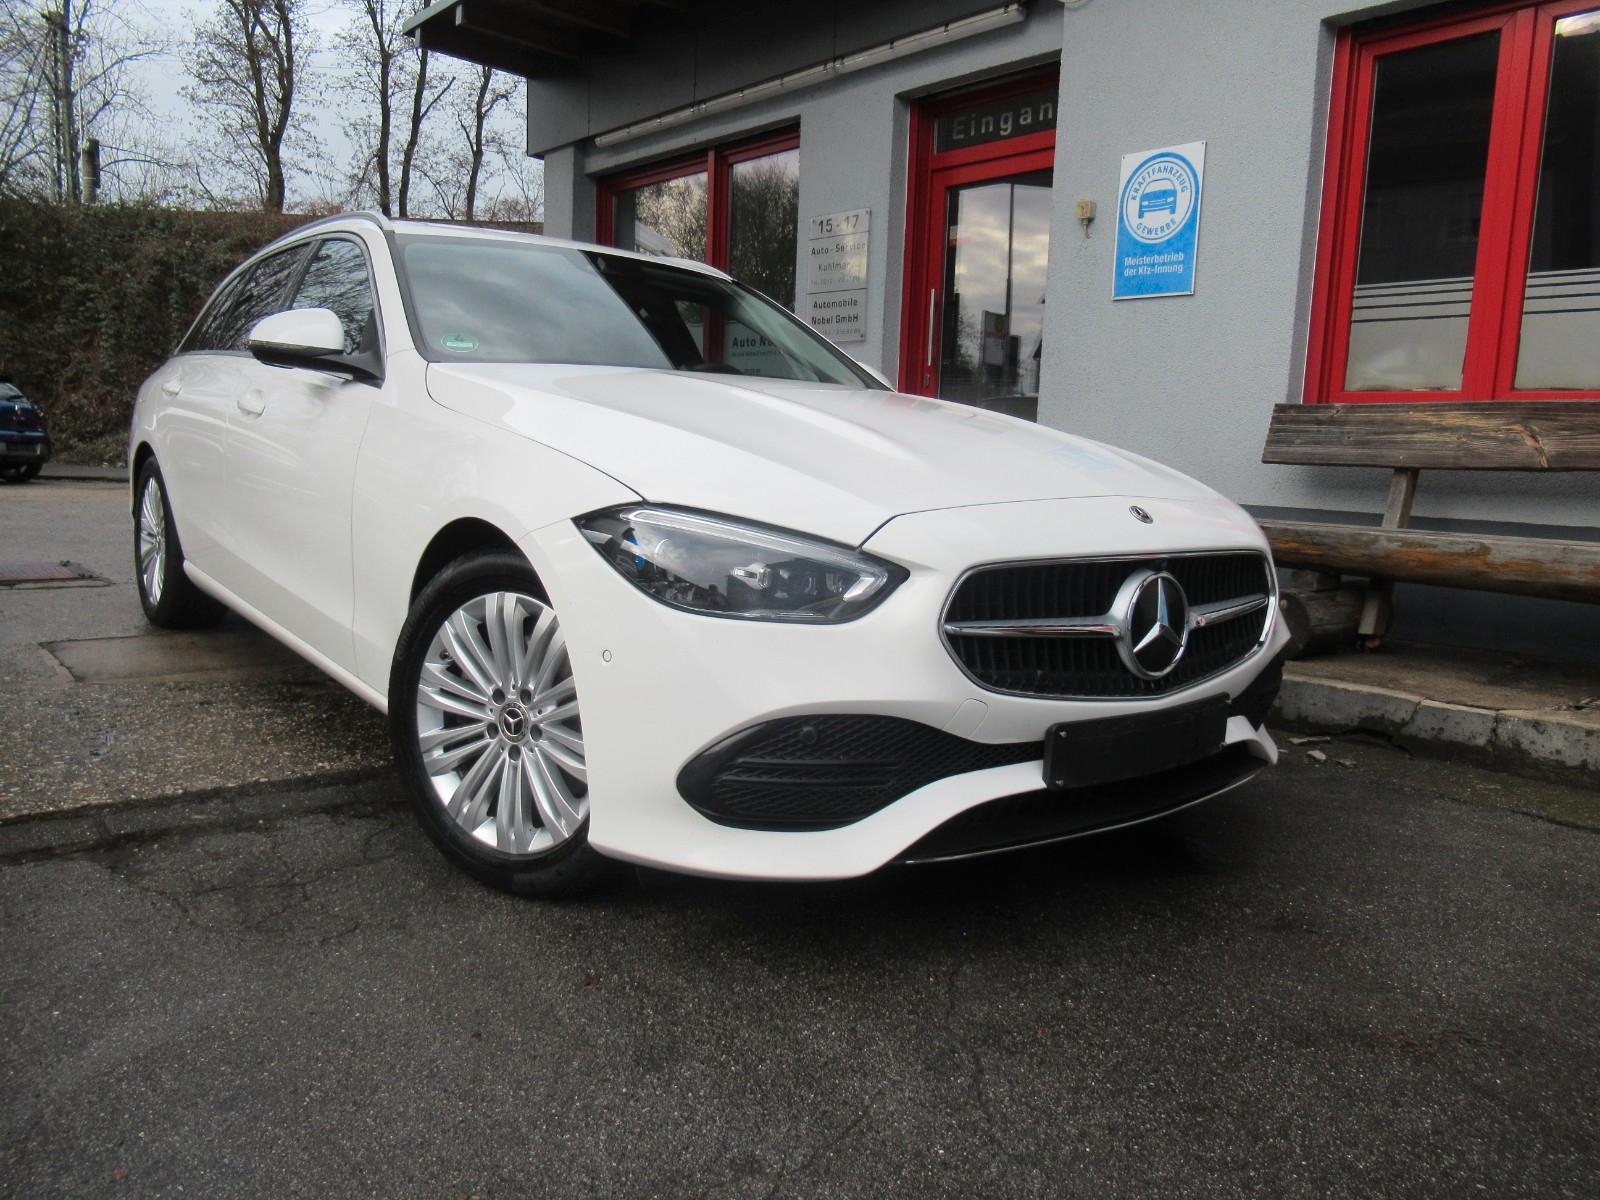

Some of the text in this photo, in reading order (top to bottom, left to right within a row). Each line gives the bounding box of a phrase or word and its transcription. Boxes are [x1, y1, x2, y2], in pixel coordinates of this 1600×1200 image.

[953, 102, 1054, 140] Eingan
[1130, 164, 1189, 201] KRAFTFAHRZEUG
[1136, 217, 1177, 236] GEWERBE
[1124, 251, 1184, 266] Meisterbetrieb
[1123, 264, 1184, 277] der Kfz-Innung
[813, 297, 858, 309] Automobile
[811, 312, 859, 325] Nobel GmbH
[732, 336, 757, 348] Auto
